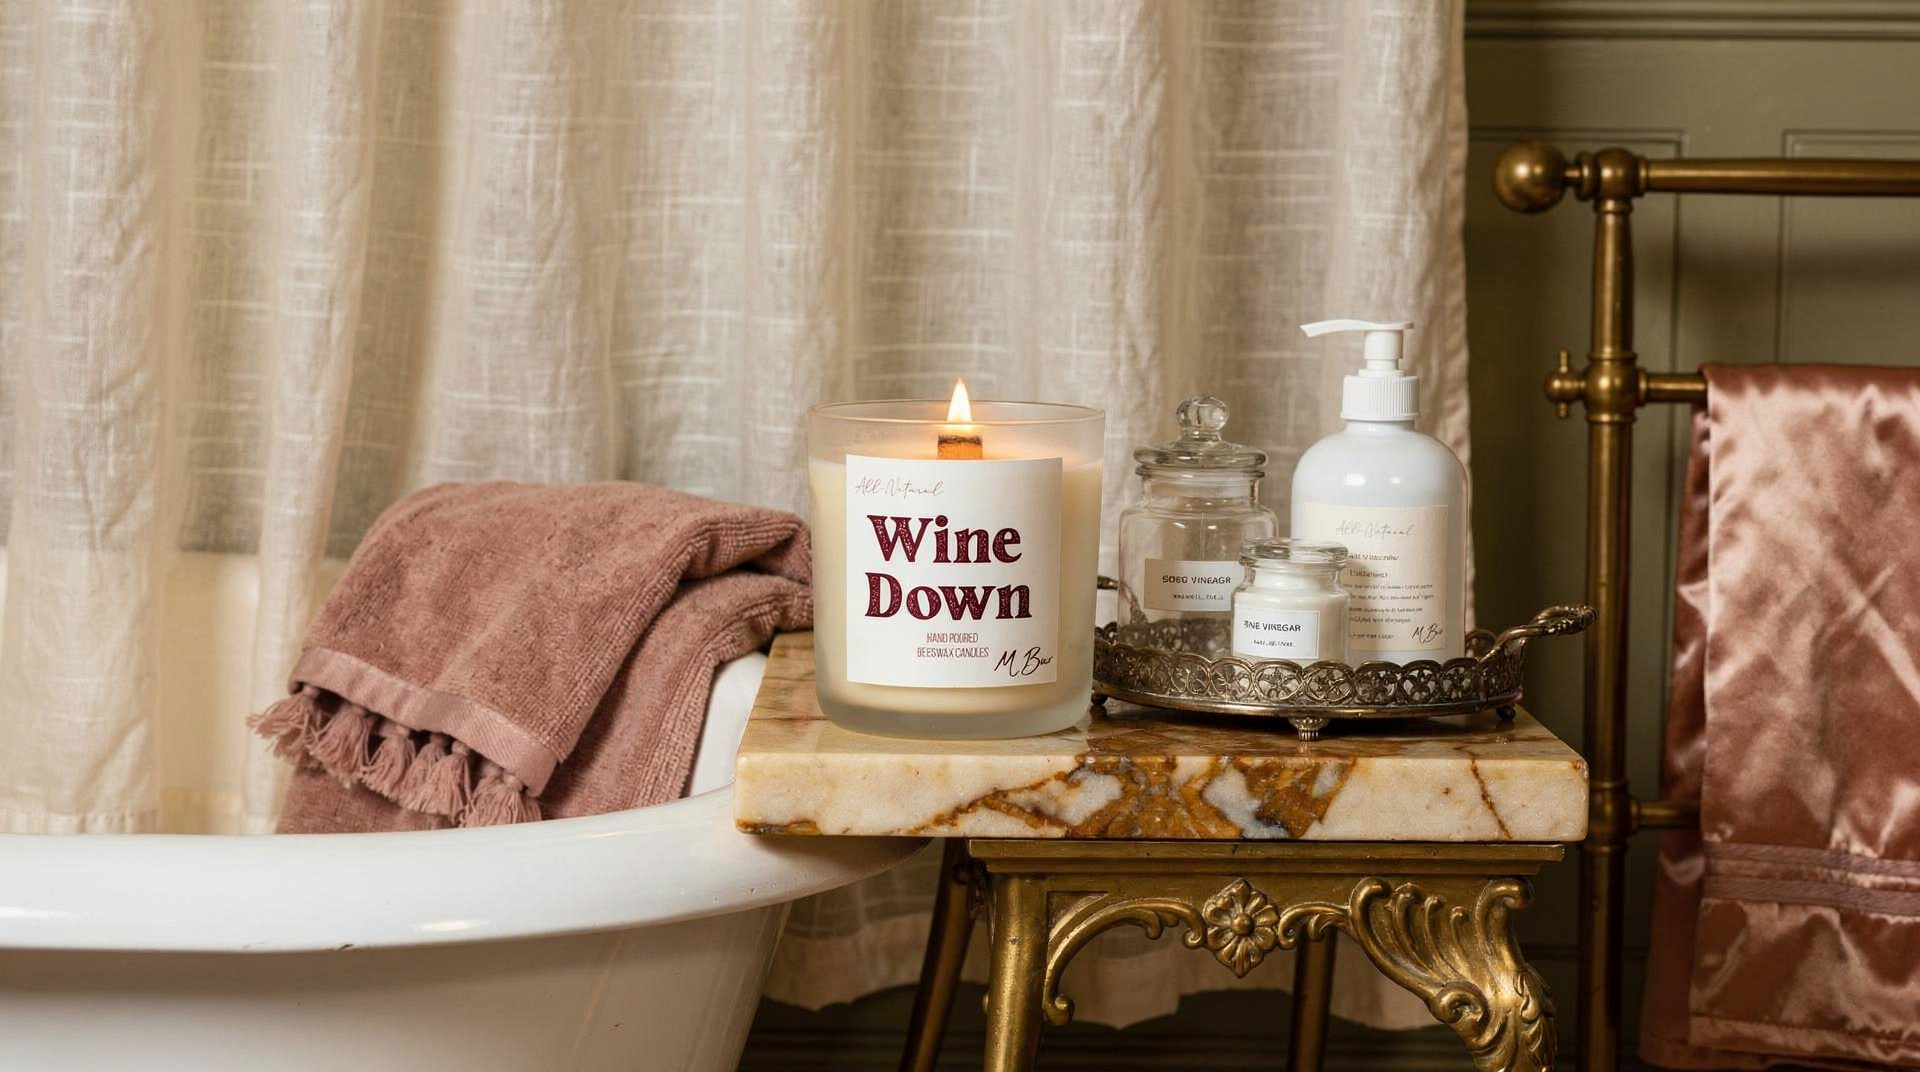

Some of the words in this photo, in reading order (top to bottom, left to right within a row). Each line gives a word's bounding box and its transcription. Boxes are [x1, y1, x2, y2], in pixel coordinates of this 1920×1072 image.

[866, 514, 1023, 564] Wine
[865, 572, 1033, 621] Down
[1262, 622, 1302, 632] VINEGAR
[926, 632, 948, 644] HAND
[949, 632, 979, 644] POURED
[917, 646, 953, 659] BEESWAX
[955, 646, 990, 659] CANDLES
[994, 649, 1020, 678] M
